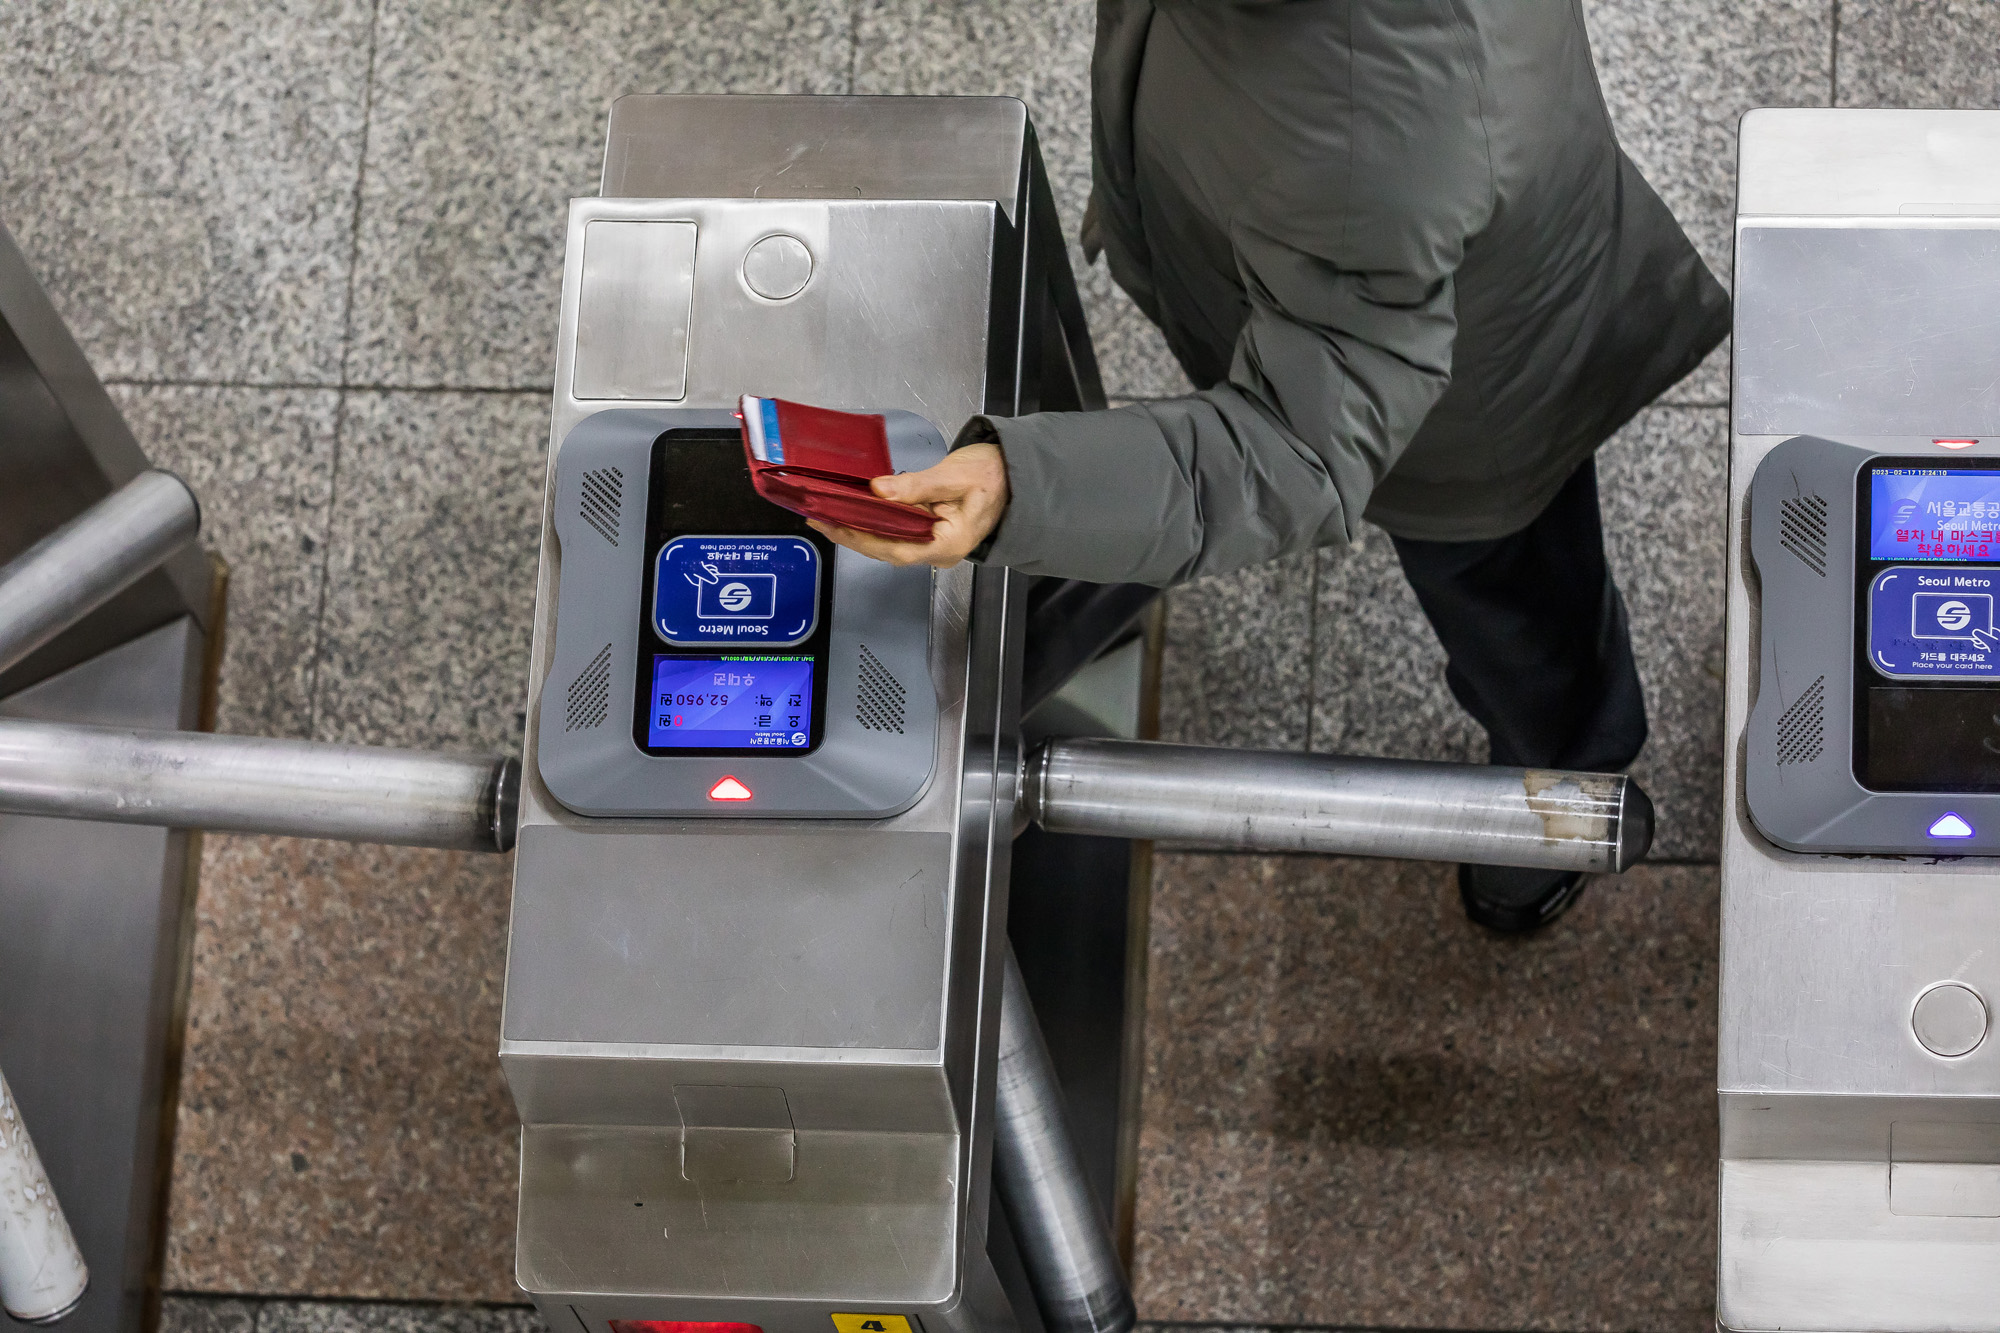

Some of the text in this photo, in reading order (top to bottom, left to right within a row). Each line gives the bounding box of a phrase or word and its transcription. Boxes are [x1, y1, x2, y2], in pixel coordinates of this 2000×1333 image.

[1937, 520, 1968, 530] Seoul
[1896, 529, 1925, 542] 열차
[1931, 530, 1944, 542] 내
[707, 552, 769, 560] 카드를 대주세요
[1918, 544, 1990, 557] 착용하세요
[1918, 576, 1990, 587] Seoul Metro
[699, 625, 768, 635] Seoul Metro
[1920, 653, 1985, 662] 카드를 대주세요
[713, 673, 756, 686] 우대권
[660, 694, 673, 706] 원
[676, 693, 728, 706] 52,950
[787, 694, 801, 707] 잔
[659, 714, 671, 727] 원
[674, 715, 683, 727] 0
[788, 715, 800, 728] 요
[861, 1320, 887, 1332] 4
